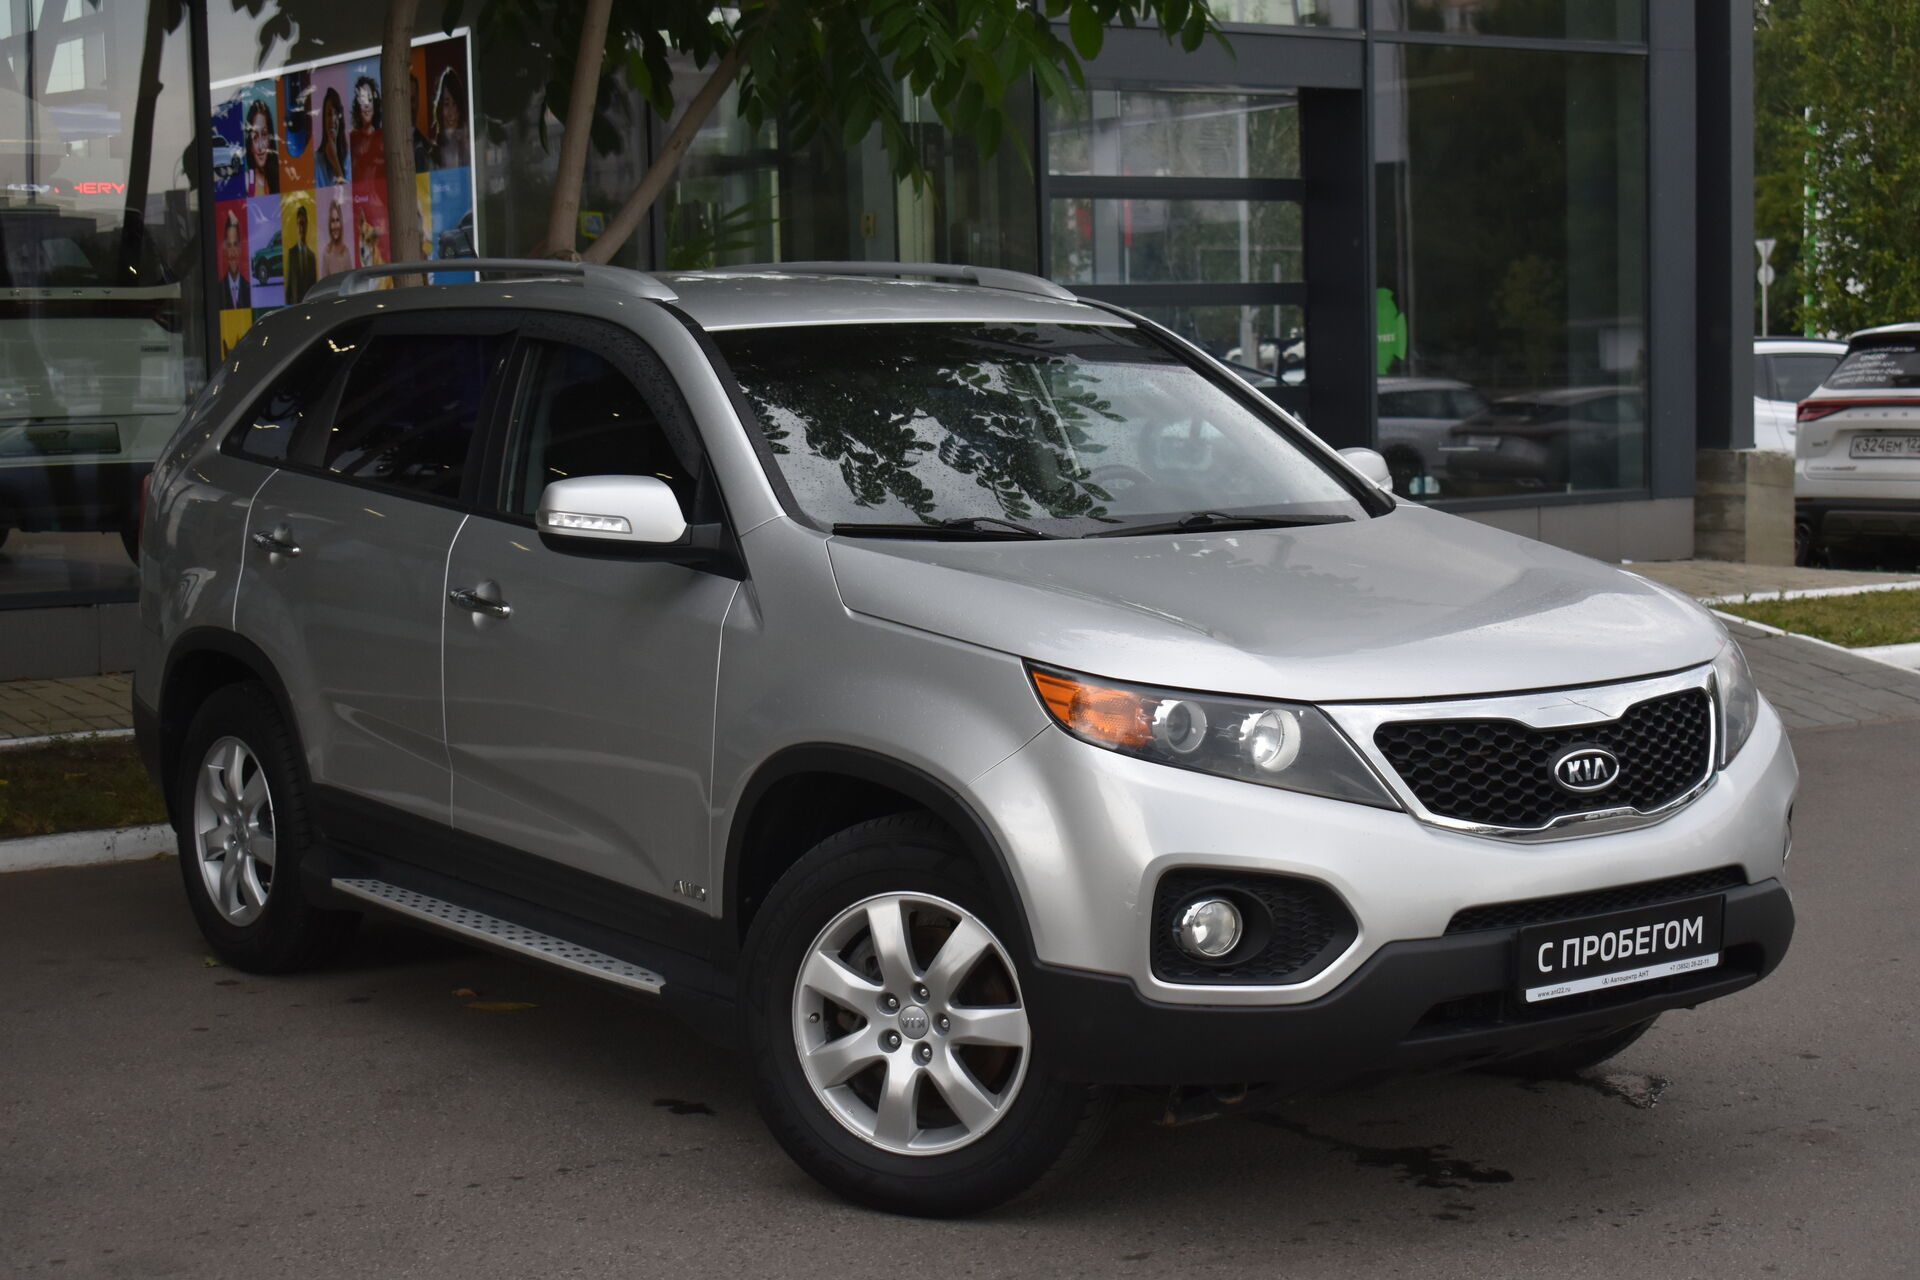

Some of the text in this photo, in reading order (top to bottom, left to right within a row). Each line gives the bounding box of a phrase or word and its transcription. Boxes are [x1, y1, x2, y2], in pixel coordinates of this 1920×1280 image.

[1567, 757, 1608, 783] KIA
[1538, 915, 1703, 973] С ПРОБЕГОМ
